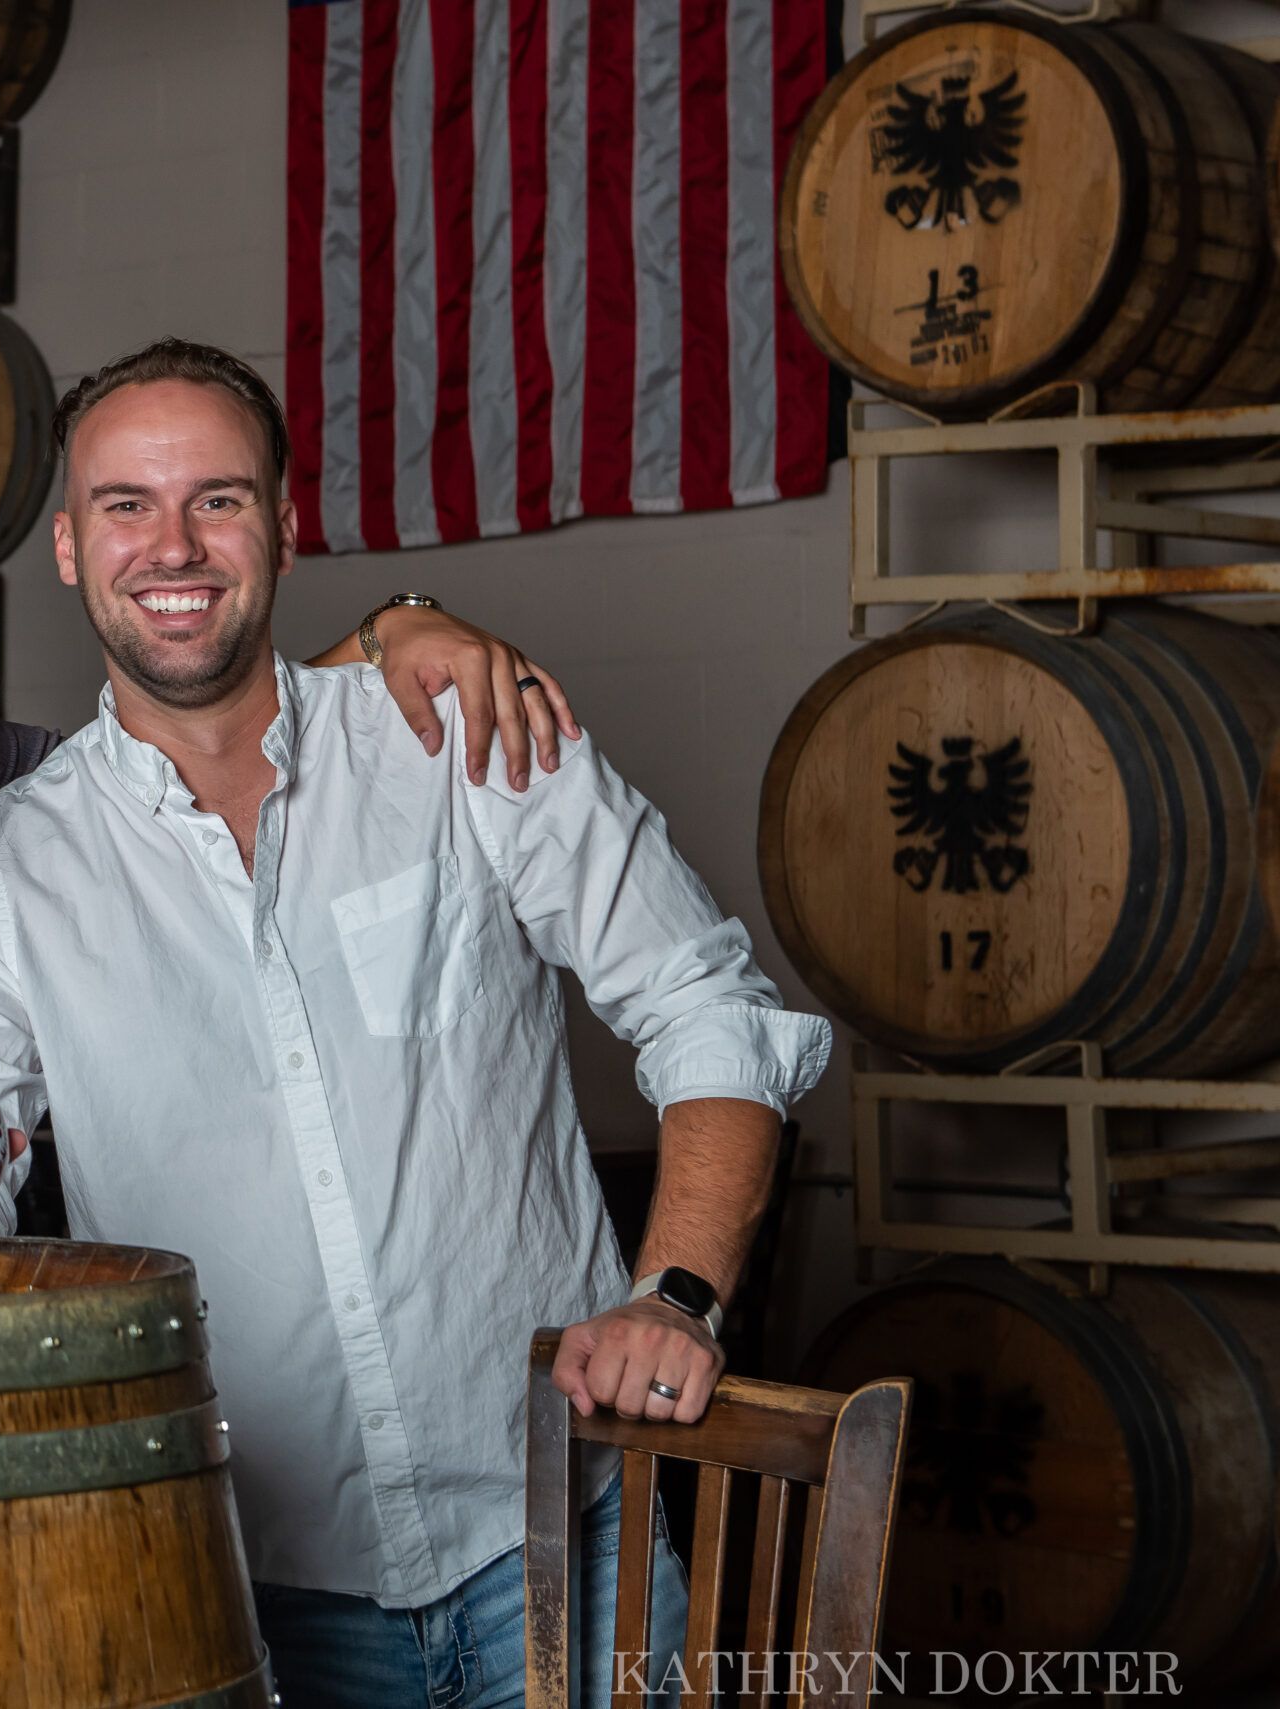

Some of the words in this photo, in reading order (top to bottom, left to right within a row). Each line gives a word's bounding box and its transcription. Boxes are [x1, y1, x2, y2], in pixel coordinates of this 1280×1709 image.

[928, 265, 977, 305] 13
[941, 931, 991, 970] 17
[951, 1585, 1004, 1626] 19
